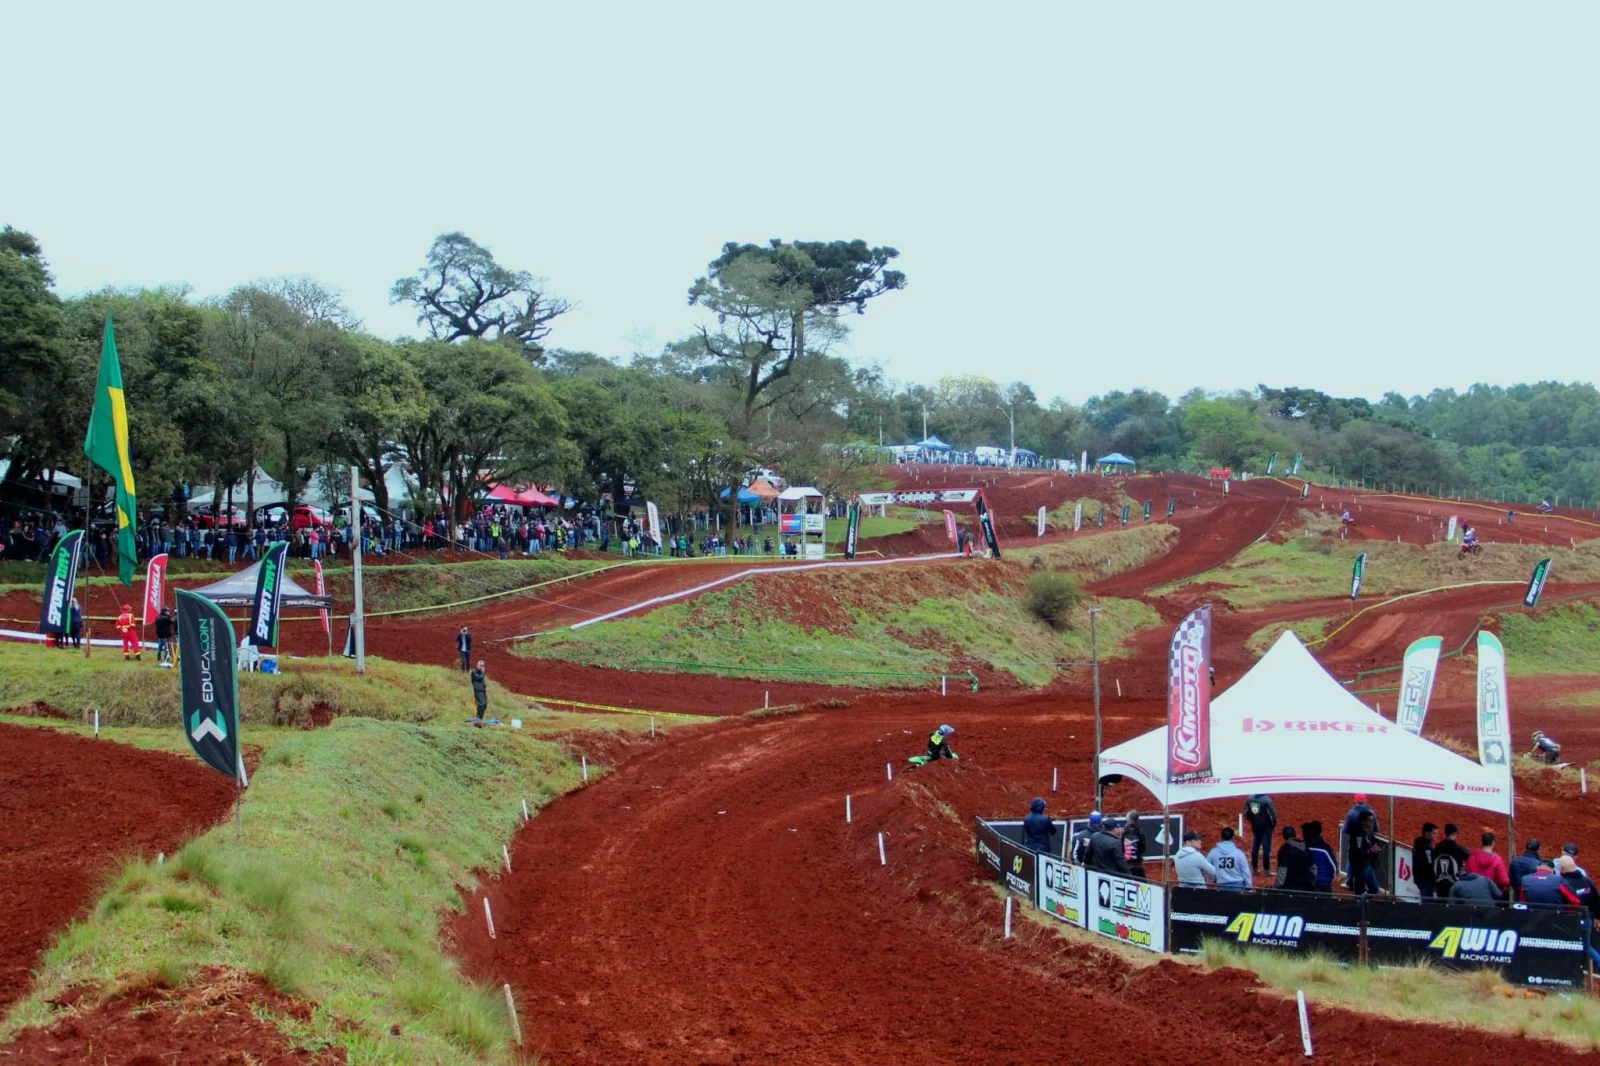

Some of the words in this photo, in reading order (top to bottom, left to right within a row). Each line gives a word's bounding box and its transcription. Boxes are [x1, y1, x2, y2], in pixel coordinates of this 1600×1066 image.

[48, 547, 71, 627] SPORTBAY
[256, 559, 277, 640] SPORTBAY
[199, 618, 214, 703] EDUCACOIN
[1218, 856, 1235, 869] 33
[1112, 880, 1151, 913] FGM
[1252, 937, 1278, 946] RACING
[1278, 939, 1298, 948] PARTS
[1460, 953, 1489, 963] RACING
[1490, 955, 1512, 964] PARTS
